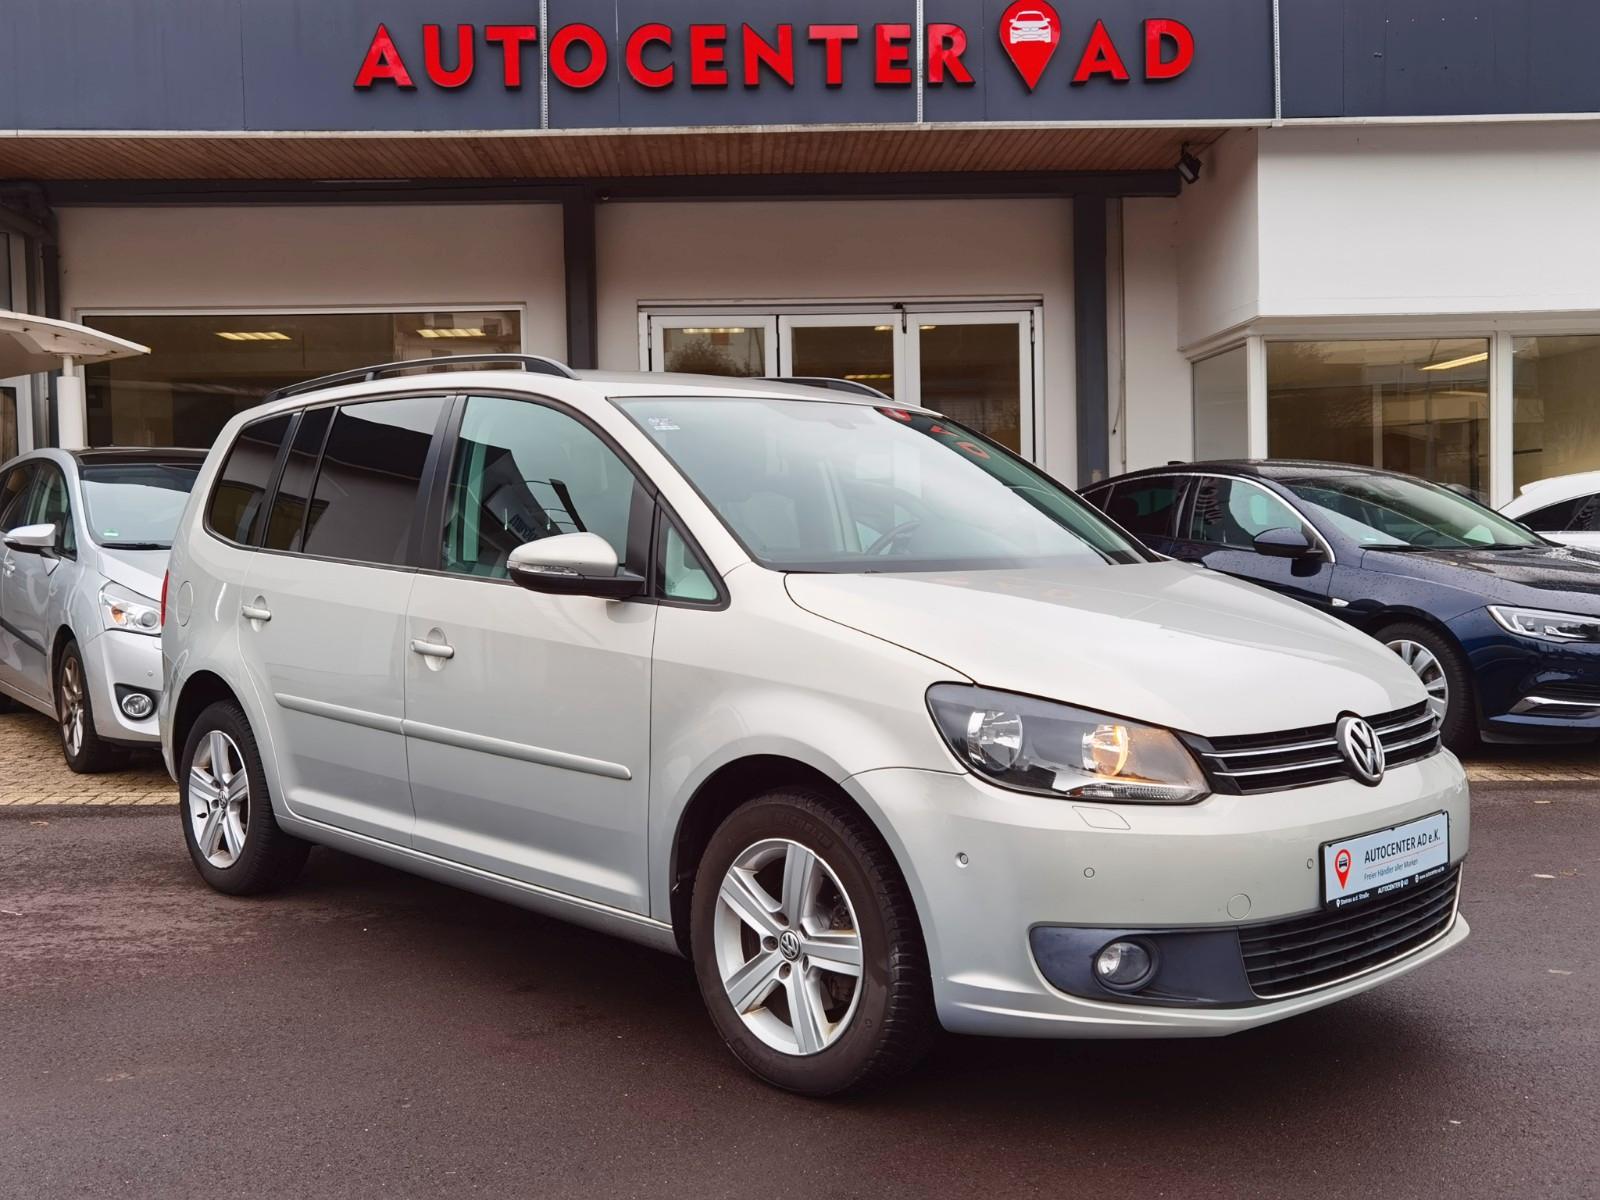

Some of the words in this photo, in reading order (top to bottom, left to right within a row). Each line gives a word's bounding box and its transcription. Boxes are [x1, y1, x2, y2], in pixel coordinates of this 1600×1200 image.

[353, 22, 976, 91] AUTOCENTER
[1070, 17, 1195, 86] AD
[1364, 836, 1416, 864] AUTOCENTER
[1416, 833, 1428, 849] AD
[1428, 828, 1441, 844] e.K.
[1363, 871, 1377, 881] Freier
